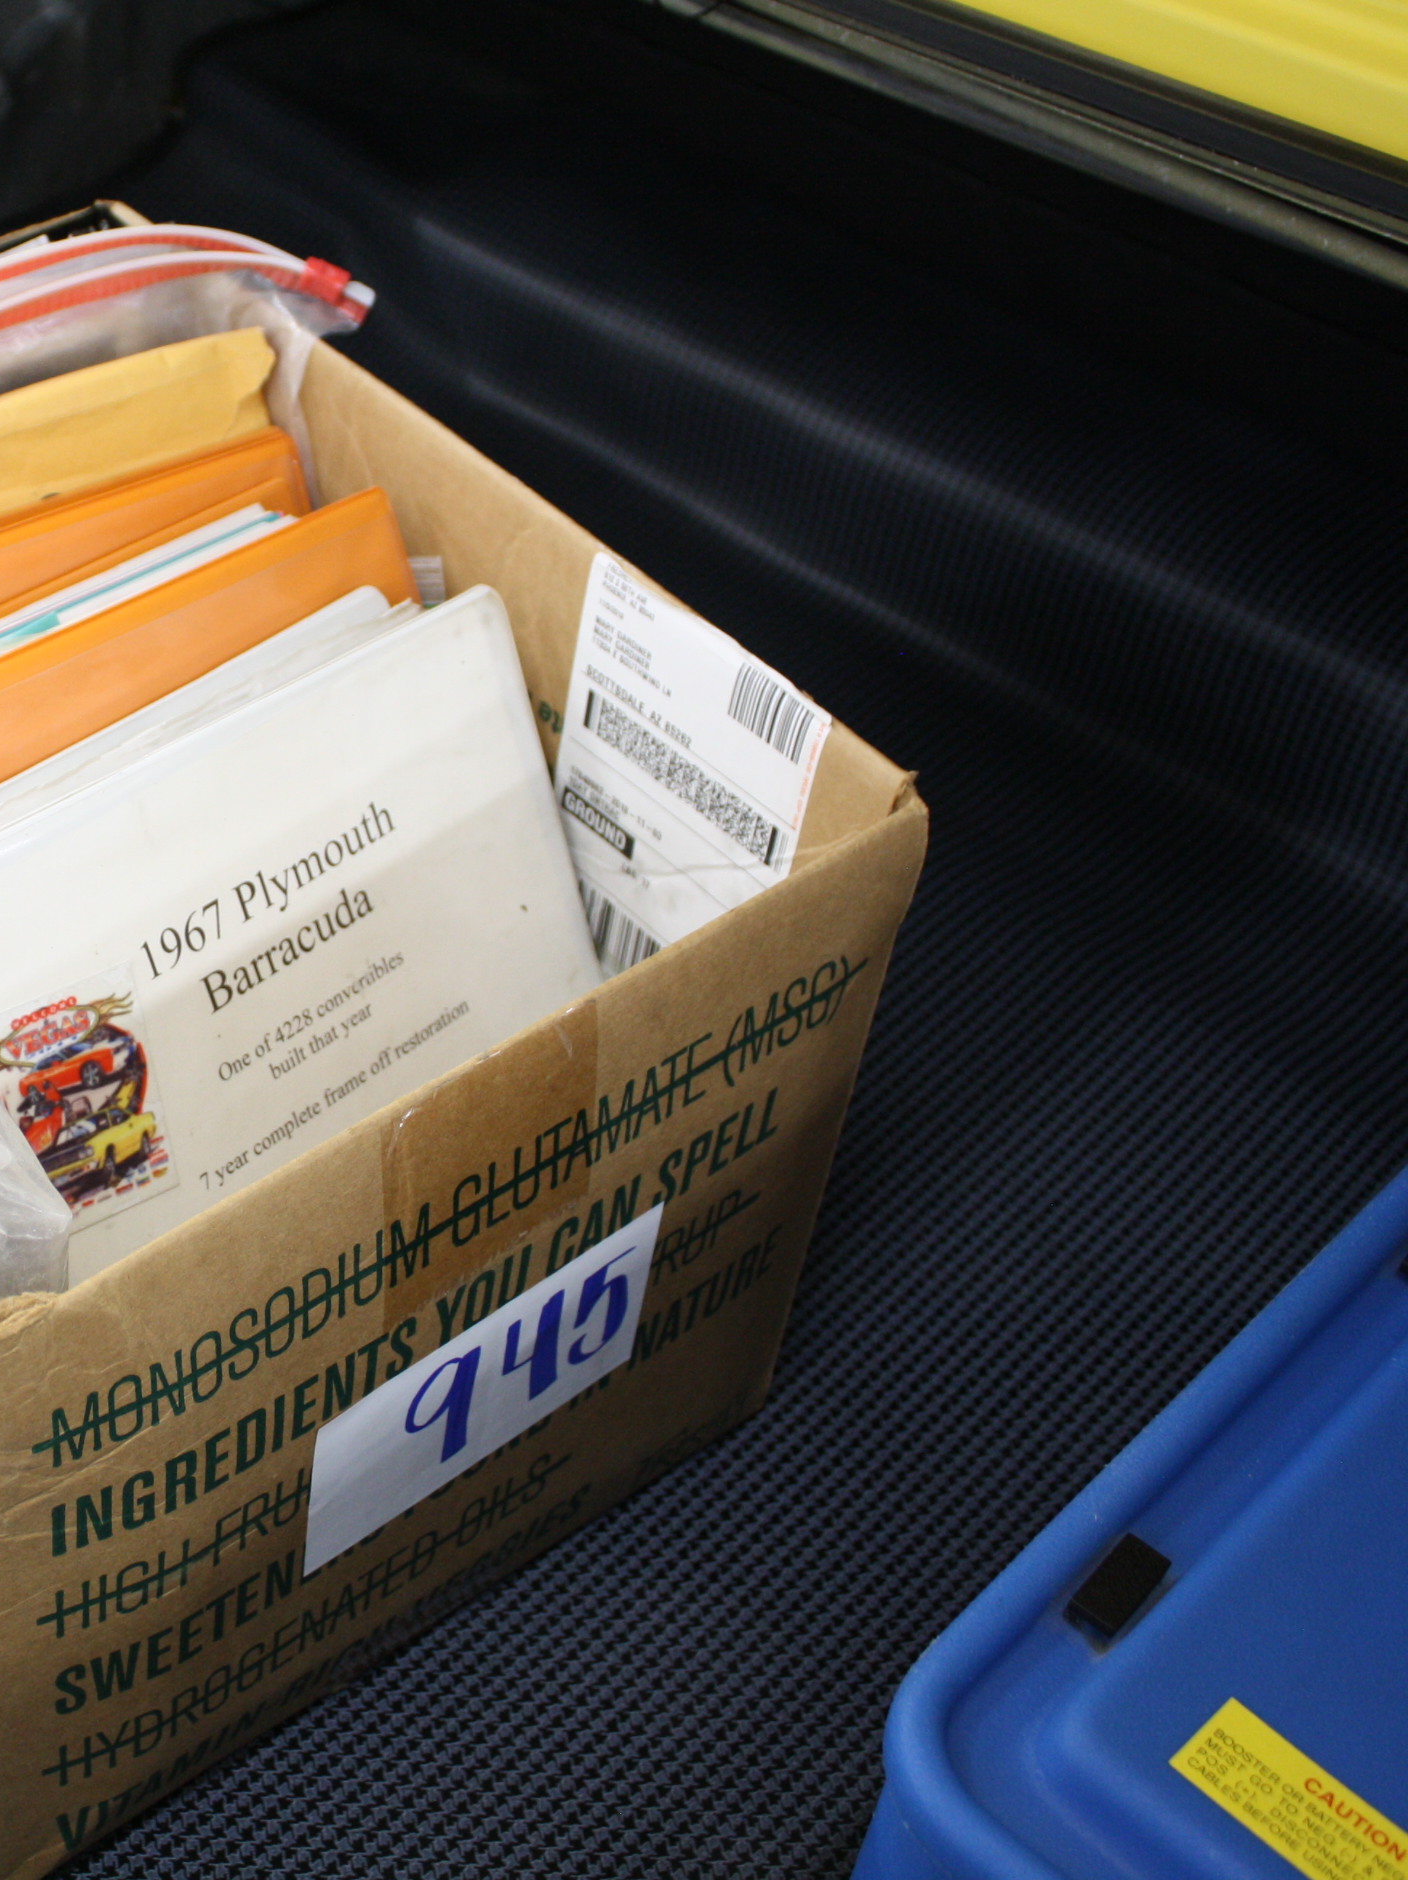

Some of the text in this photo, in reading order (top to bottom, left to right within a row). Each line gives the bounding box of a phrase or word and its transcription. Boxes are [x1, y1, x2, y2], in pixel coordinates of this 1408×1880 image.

[586, 664, 645, 712] SCOTTSDALE
[565, 790, 628, 851] GROUND
[139, 801, 397, 981] 1967 Plymouth
[199, 884, 376, 1014] Barracuda
[5, 1009, 90, 1059] VEGAS
[13, 997, 75, 1031] WELCOME
[217, 1055, 253, 1084] One
[254, 1038, 275, 1066] of
[274, 1008, 316, 1054] 4228
[269, 1004, 375, 1082] built that year
[199, 1169, 212, 1192] 7
[213, 1150, 251, 1188] year
[252, 1101, 322, 1164] complete
[323, 1068, 368, 1112] frame
[369, 1050, 394, 1080] off
[392, 1000, 471, 1068] restoration
[51, 1202, 432, 1467] MONOSODIUM
[451, 1033, 712, 1247] GLUTAMATE
[722, 953, 851, 1087] (MSG)
[51, 1316, 417, 1558] INGREDIENTS
[435, 1243, 533, 1347] YOU
[546, 1174, 641, 1277] CAN
[651, 1087, 780, 1208] SPELL
[404, 1245, 638, 1464] 945
[628, 1225, 782, 1371] NATURE
[55, 1538, 190, 1638] HIGH
[58, 1452, 552, 1787] HYDROGENATED OILS
[1187, 1756, 1241, 1803] CABLES
[1242, 1801, 1296, 1850] BEFORE
[1195, 1746, 1229, 1777] POS
[1269, 1806, 1368, 1880] DISCONNEC
[1205, 1737, 1247, 1774] MUST
[1249, 1773, 1274, 1797] GO
[1279, 1798, 1298, 1817] TO
[1303, 1816, 1336, 1846] NEG
[1213, 1728, 1281, 1785] BOOSTER
[1281, 1783, 1304, 1804] OR
[1305, 1802, 1369, 1854] BATTERY
[1303, 1776, 1408, 1861] CAUTION
